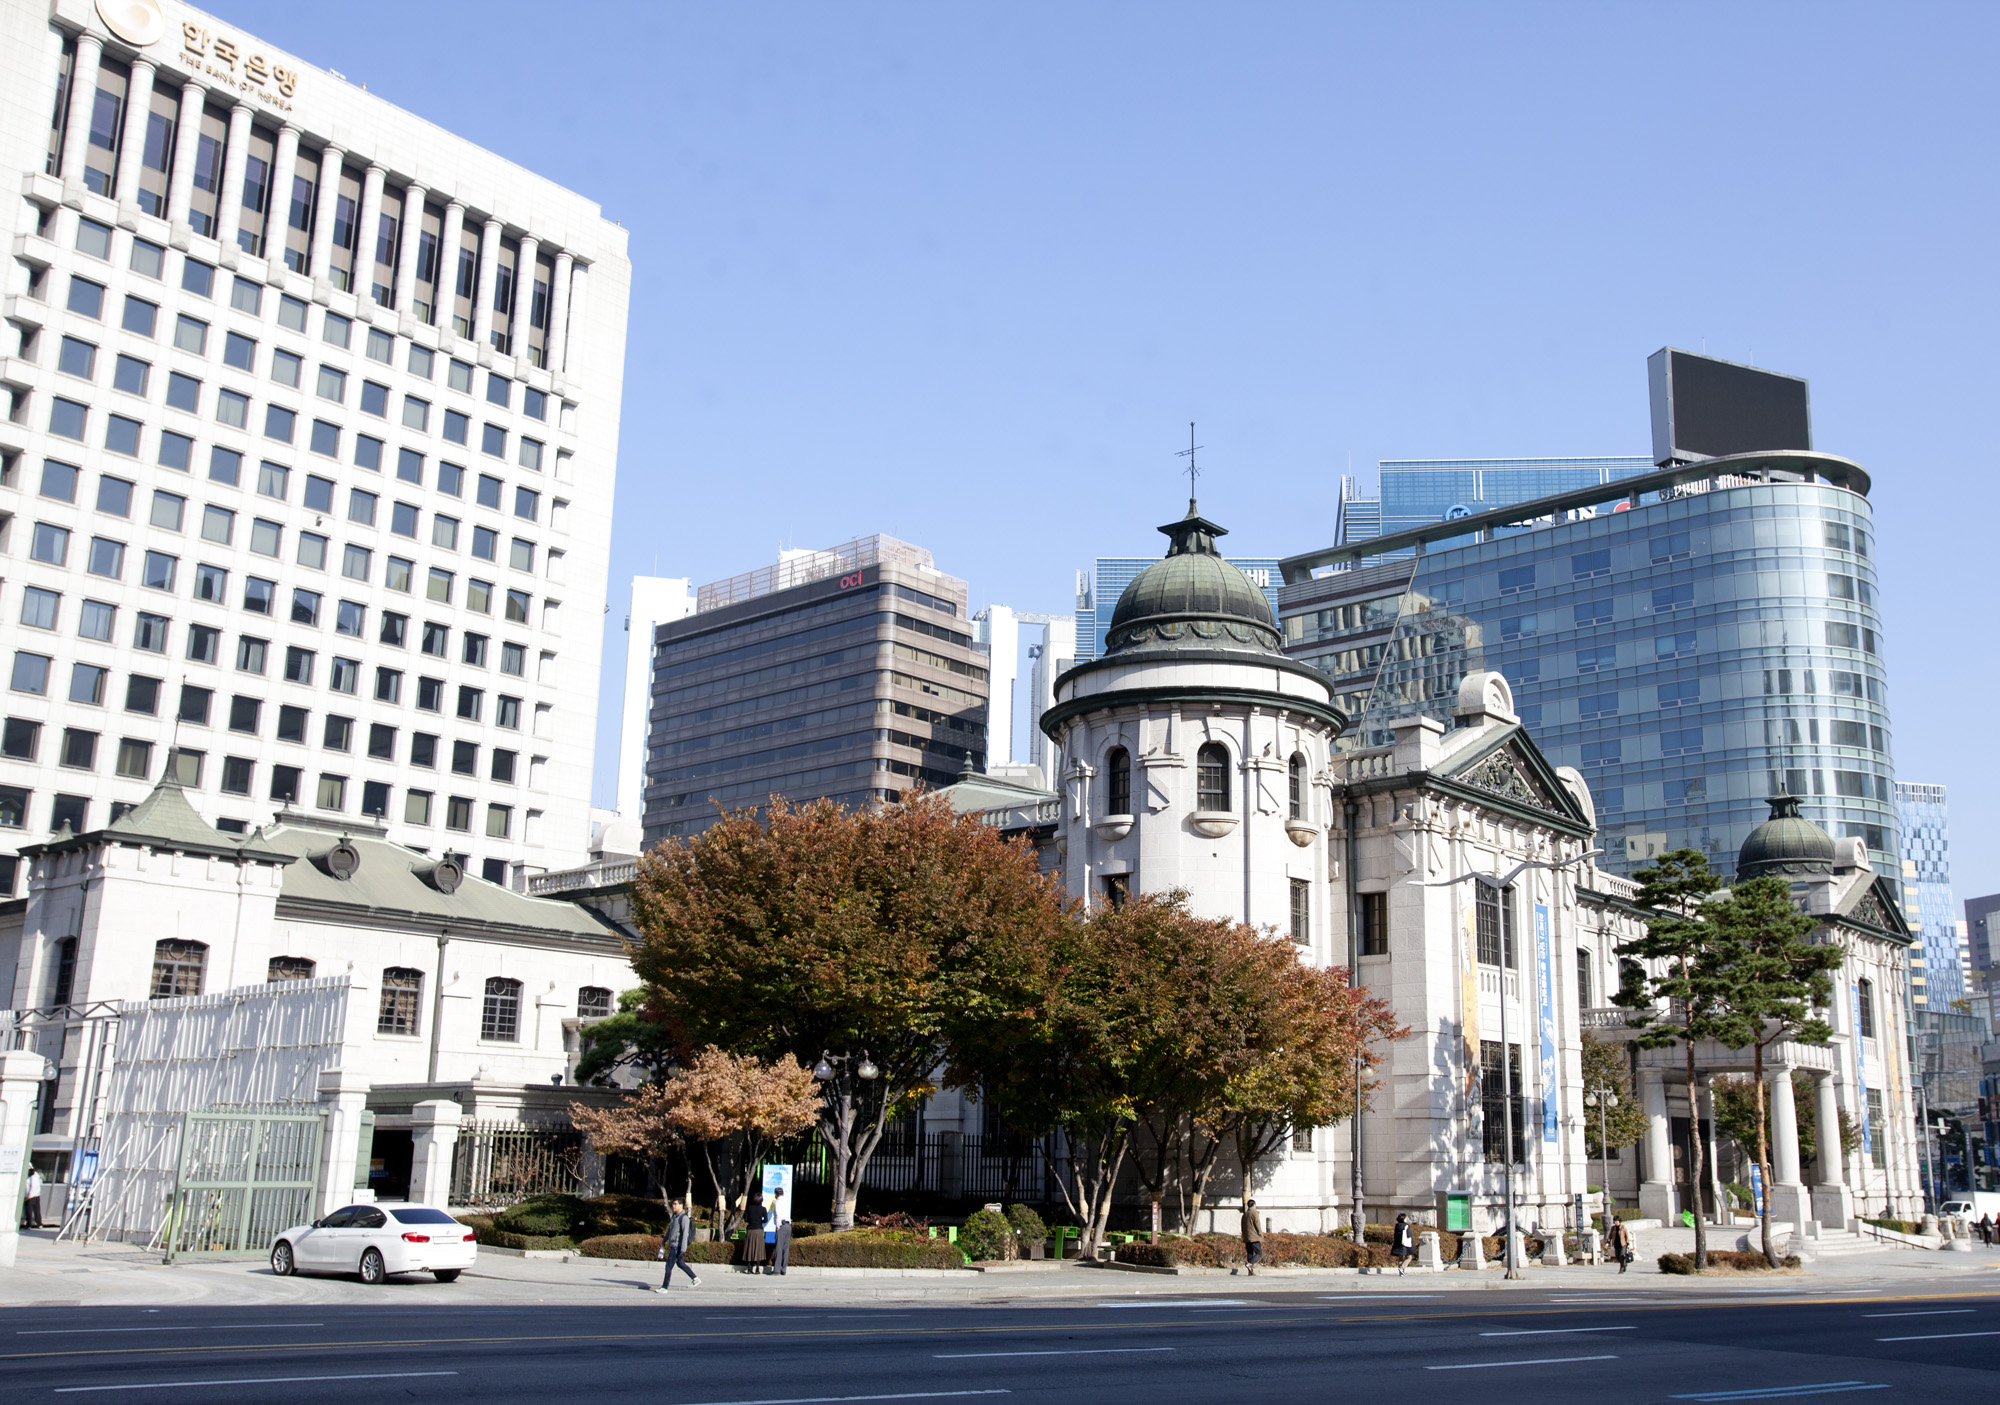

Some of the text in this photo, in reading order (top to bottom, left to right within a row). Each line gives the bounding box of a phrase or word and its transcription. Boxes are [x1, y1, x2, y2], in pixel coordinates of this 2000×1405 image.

[179, 52, 292, 112] THE BANK OF KOREA
[183, 21, 298, 98] 한국은행
